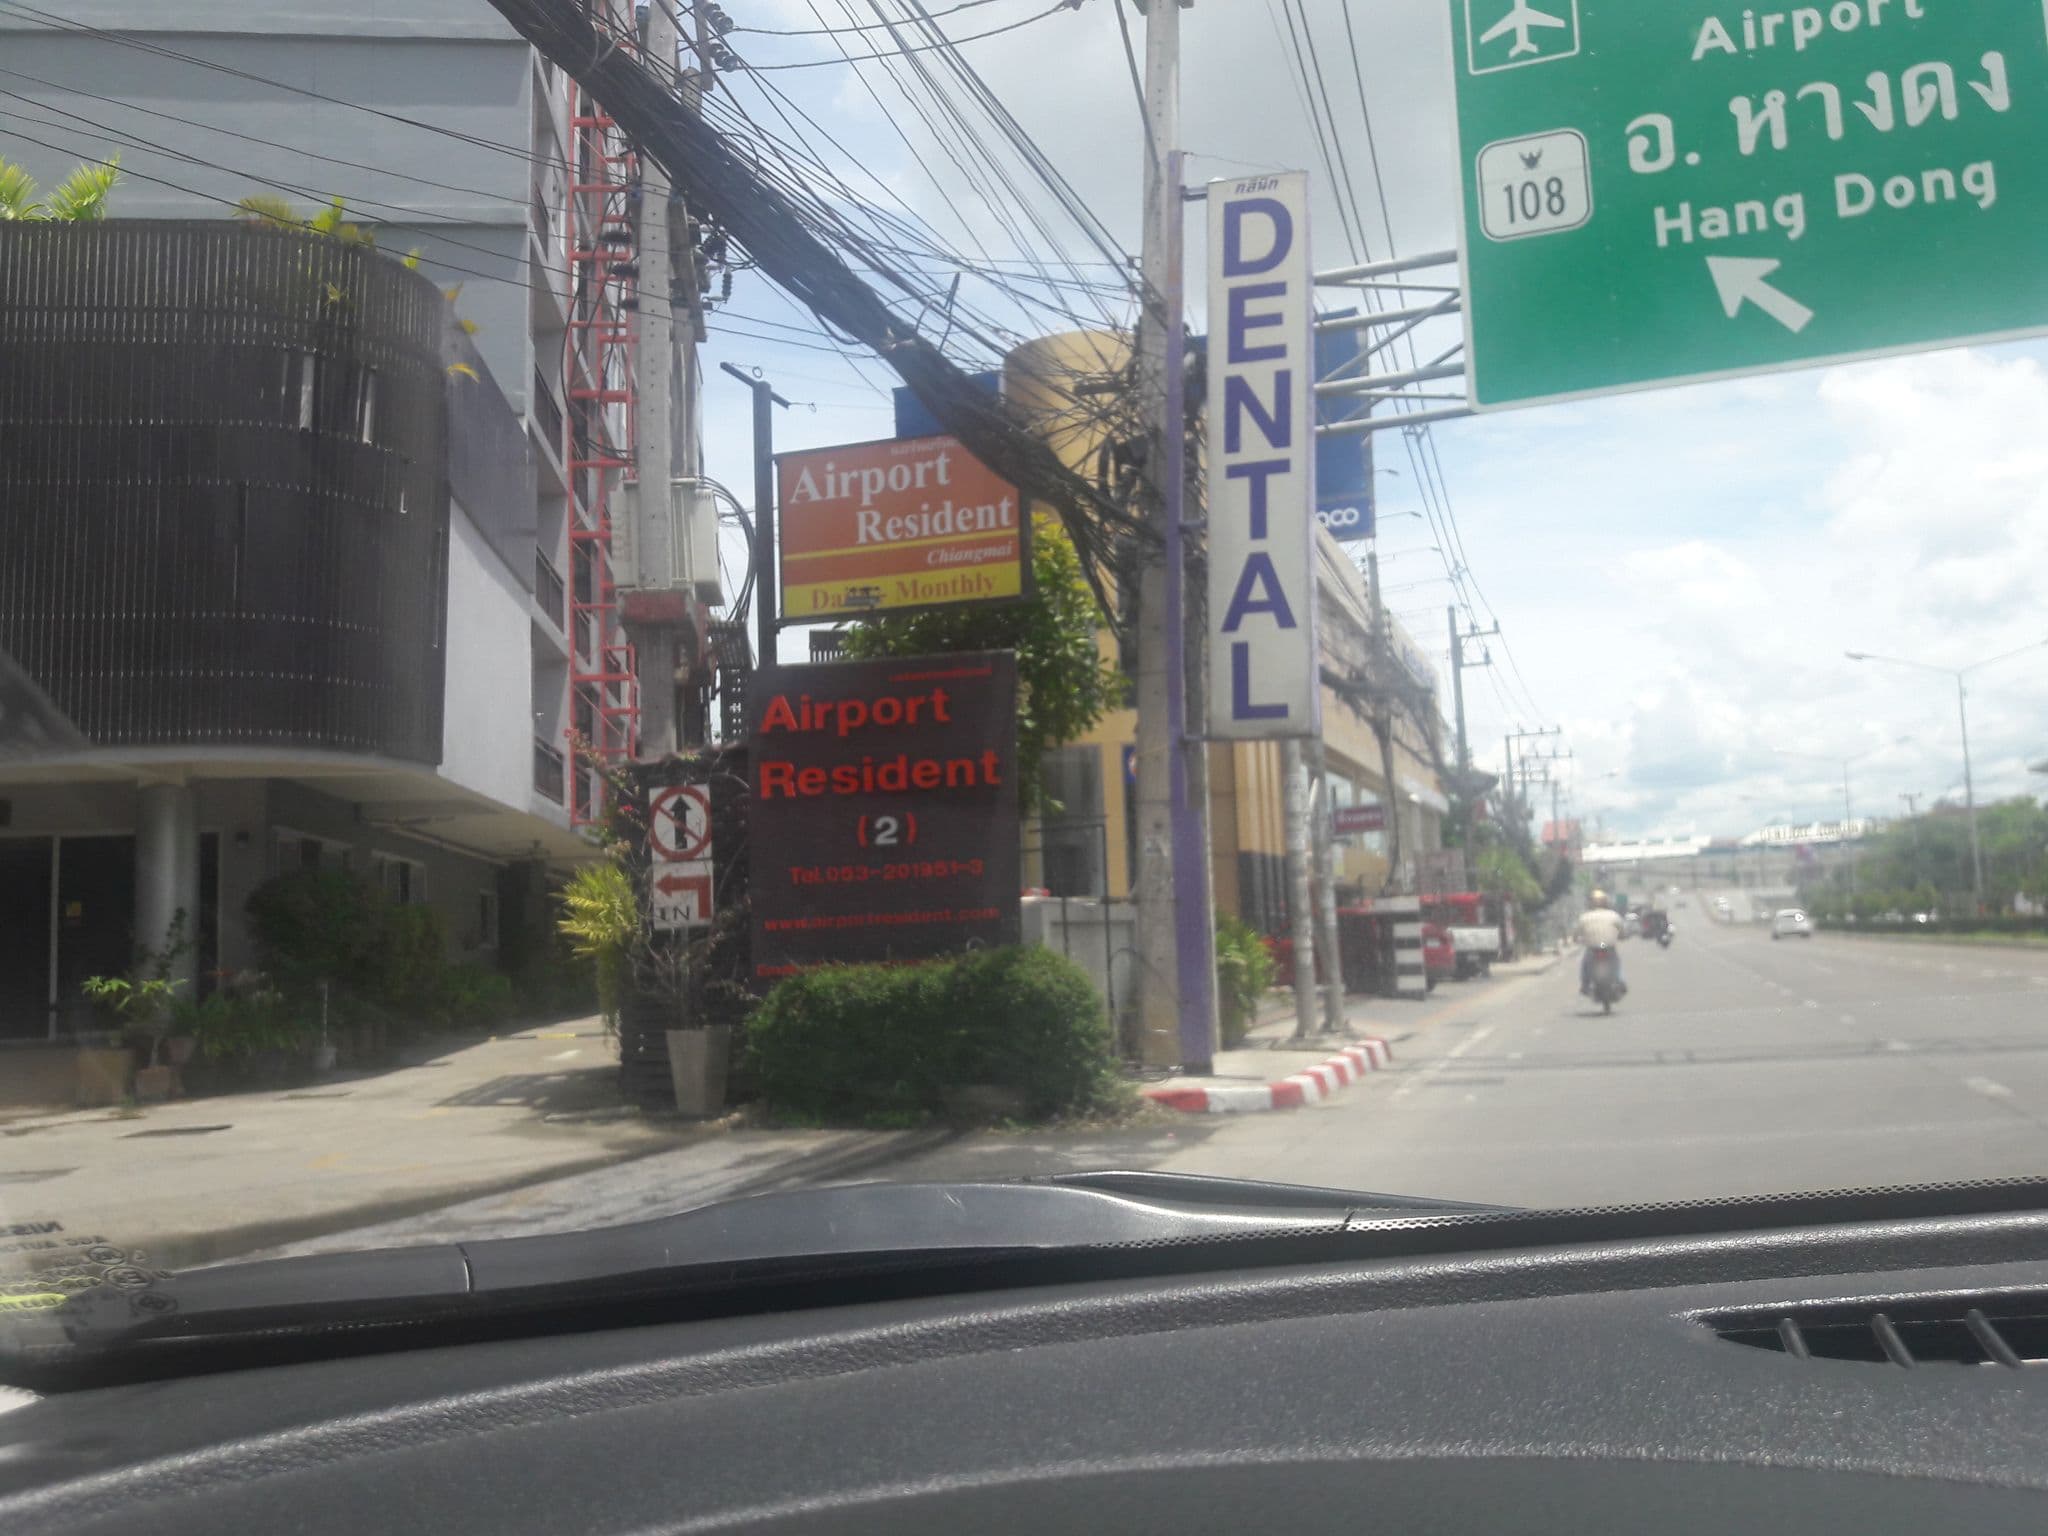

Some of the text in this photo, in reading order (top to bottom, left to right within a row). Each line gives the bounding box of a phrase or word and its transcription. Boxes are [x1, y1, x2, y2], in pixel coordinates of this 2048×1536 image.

[1691, 0, 1924, 61] Airport
[1502, 176, 1567, 225] 108
[1653, 160, 1998, 248] Hang Dong
[789, 452, 952, 507] Airport
[1223, 198, 1297, 720] DENTAL
[856, 496, 1013, 545] Resident
[926, 541, 1013, 567] Chiangmai
[896, 571, 996, 602] Monthly
[759, 688, 950, 737] Airport
[759, 750, 1001, 799] Resident
